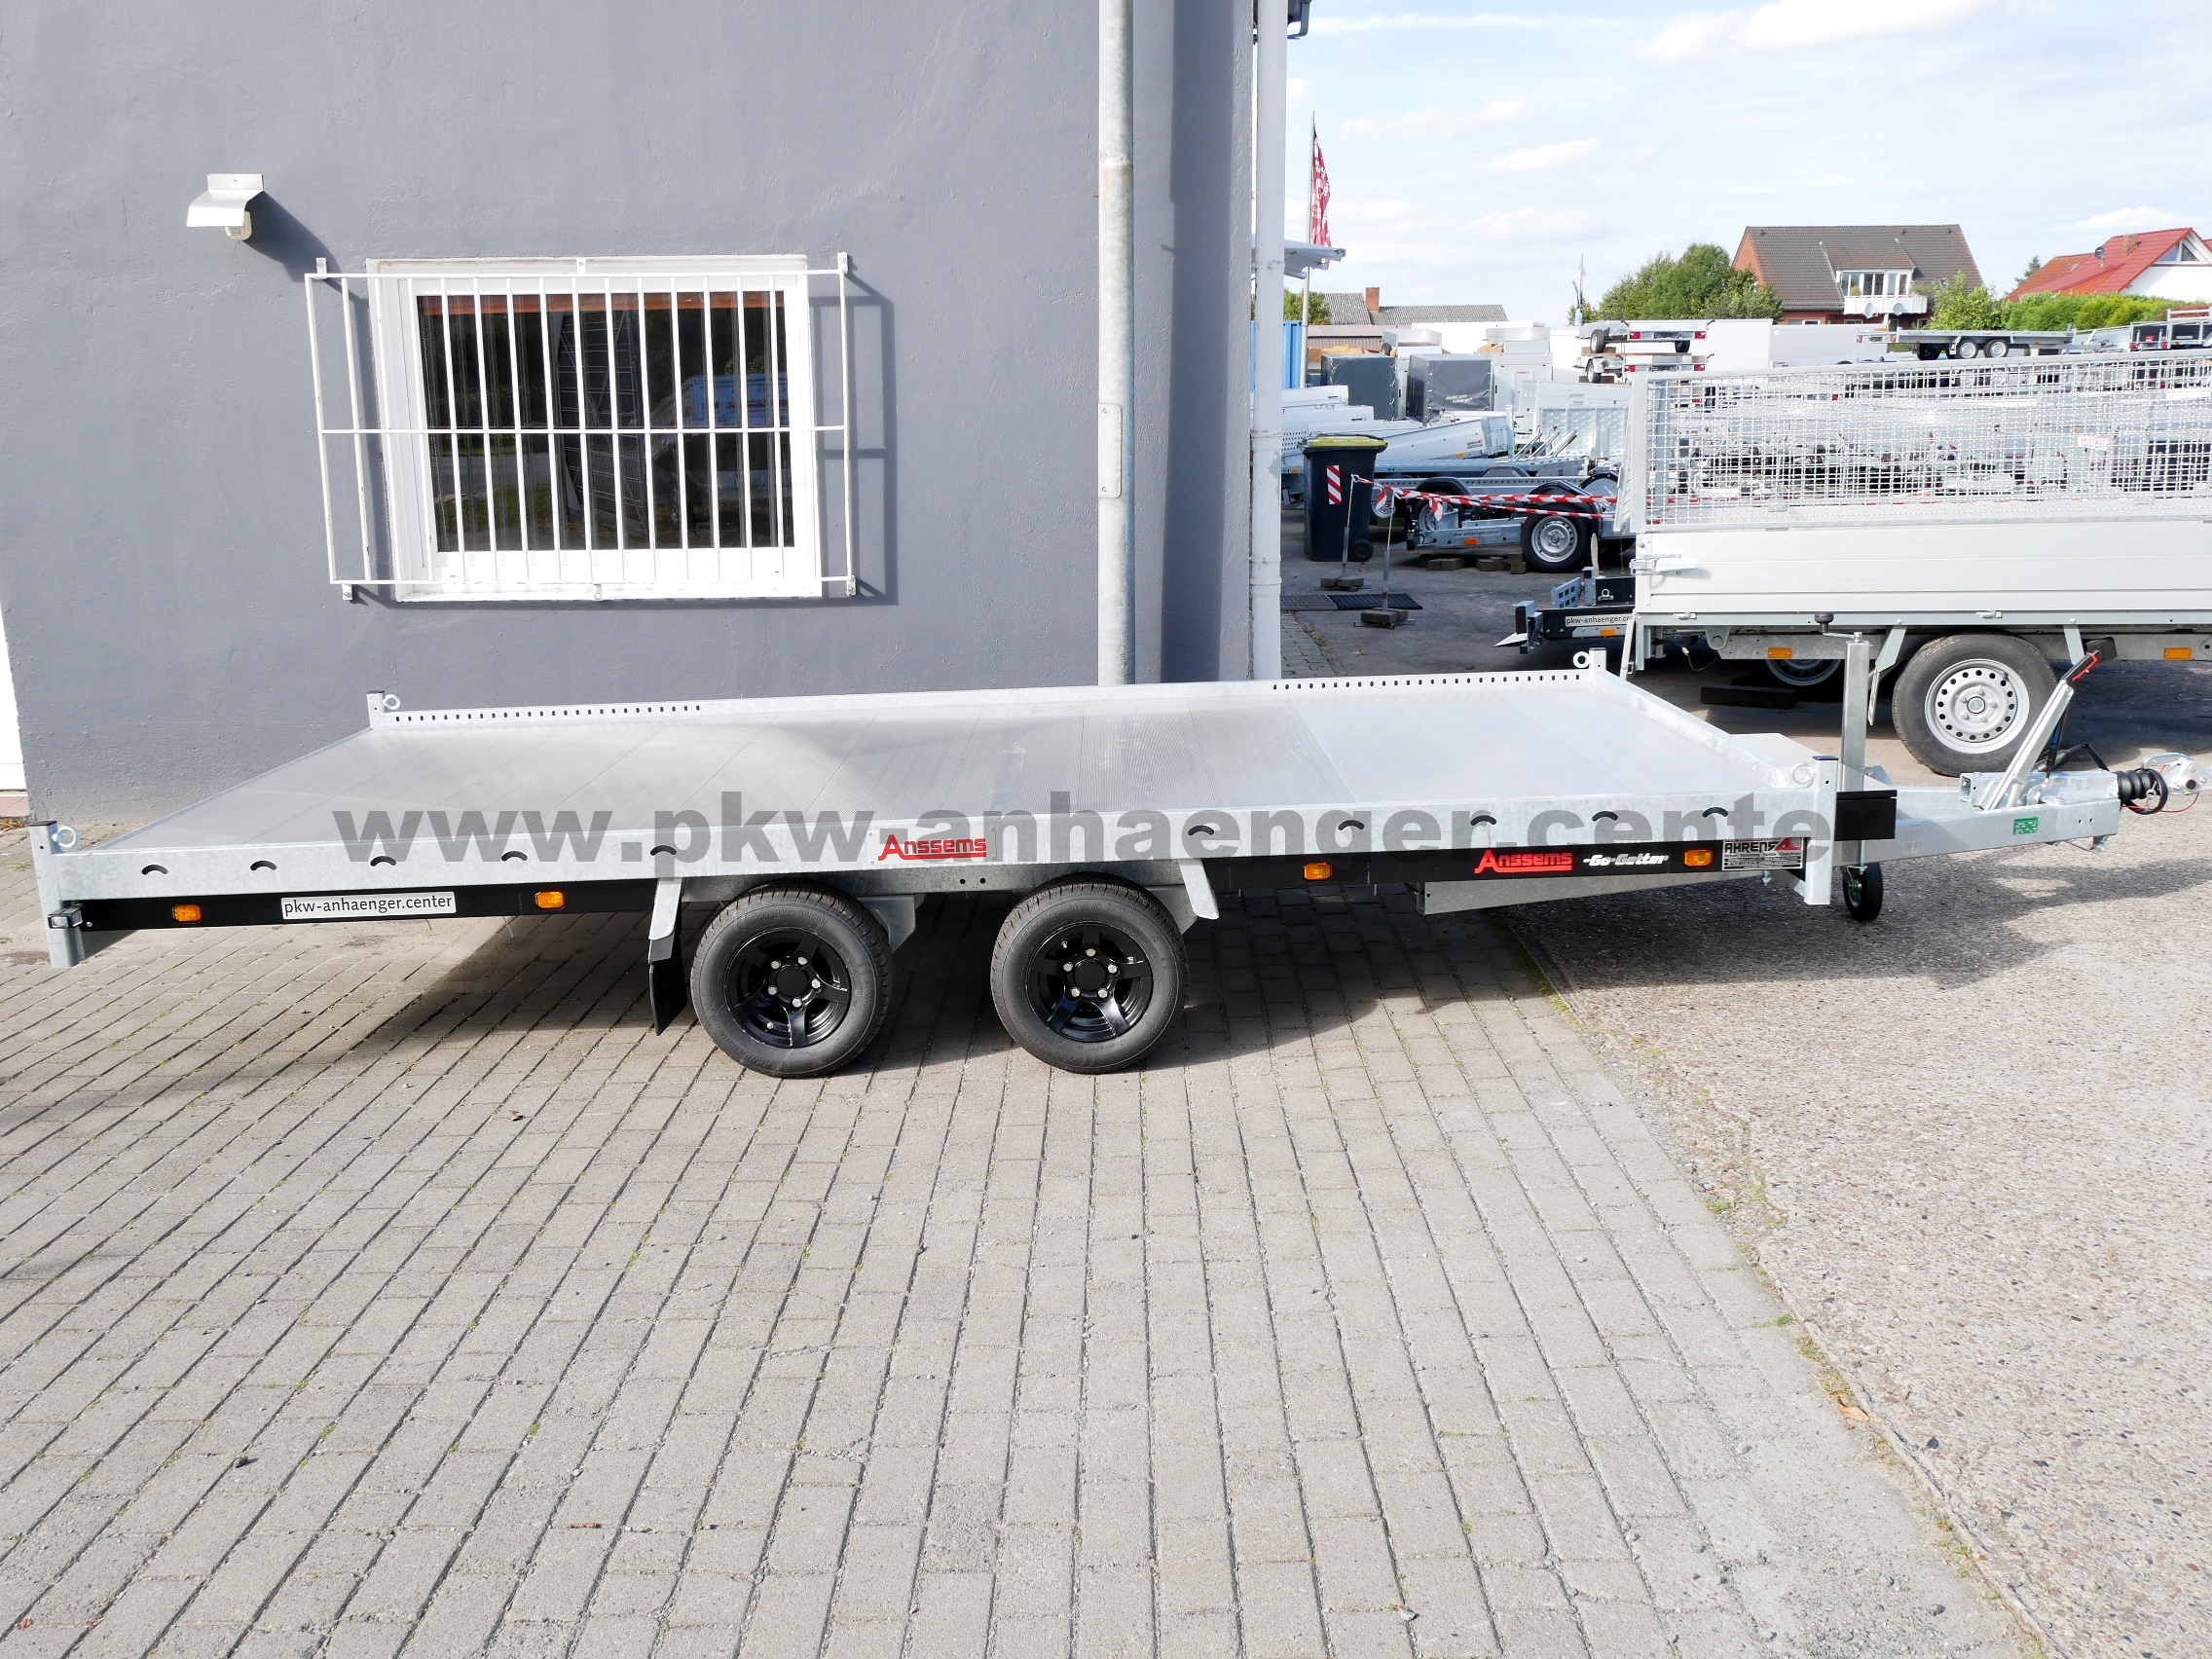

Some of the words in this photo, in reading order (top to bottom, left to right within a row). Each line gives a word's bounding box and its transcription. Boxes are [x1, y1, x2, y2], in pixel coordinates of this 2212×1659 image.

[1566, 615, 1631, 626] pkw-anhaenger.ce
[878, 833, 986, 861] Anssems
[1724, 842, 1779, 853] AHRENS
[1474, 849, 1572, 873] Anssems
[283, 895, 453, 917] pkw-anhaenger.center
